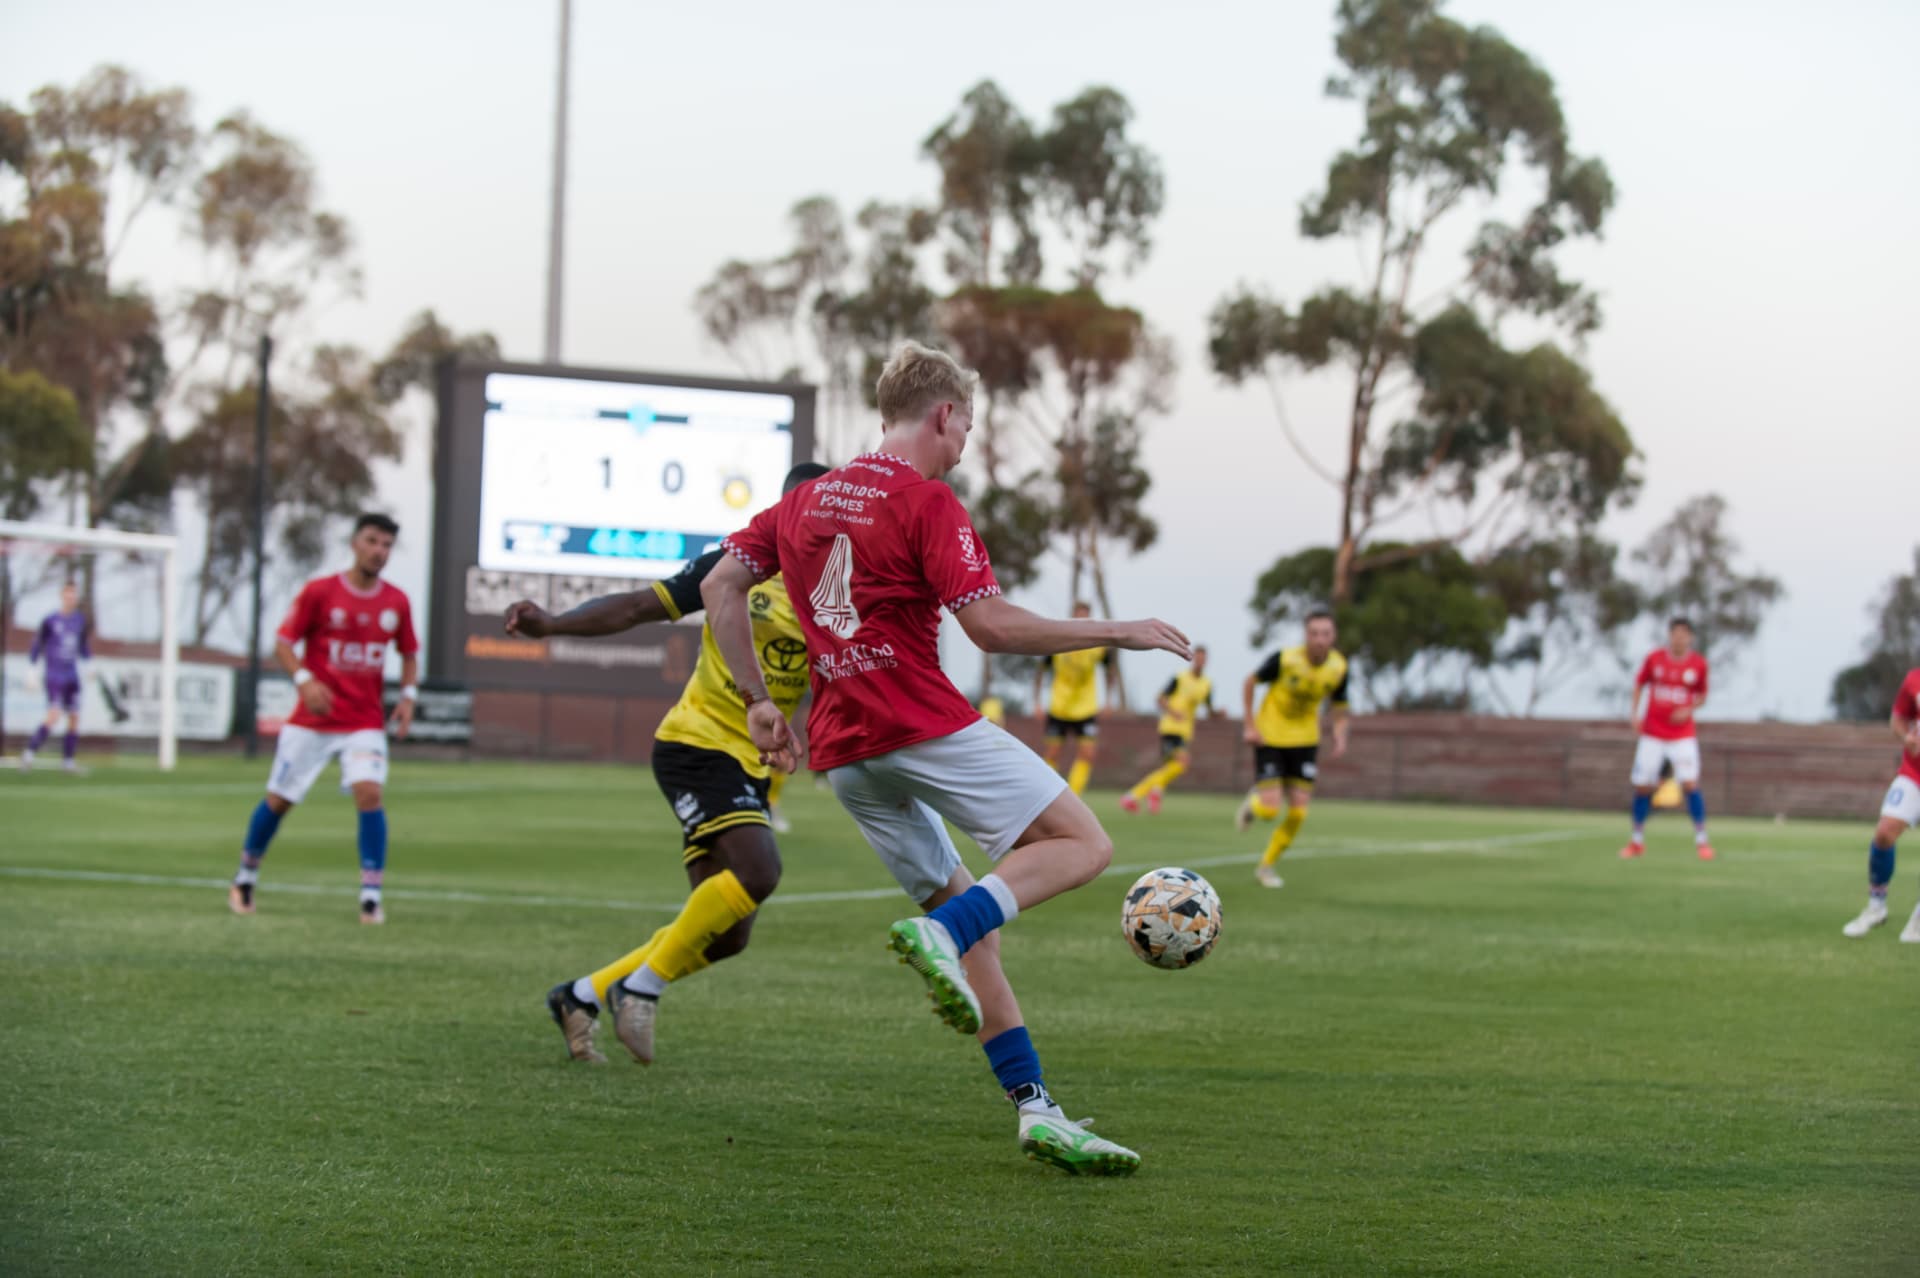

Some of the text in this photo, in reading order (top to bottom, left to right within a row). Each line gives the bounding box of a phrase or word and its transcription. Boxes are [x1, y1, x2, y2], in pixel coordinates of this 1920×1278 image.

[600, 456, 684, 494] 1 0
[810, 533, 861, 640] 4
[764, 673, 805, 688] OYOTA
